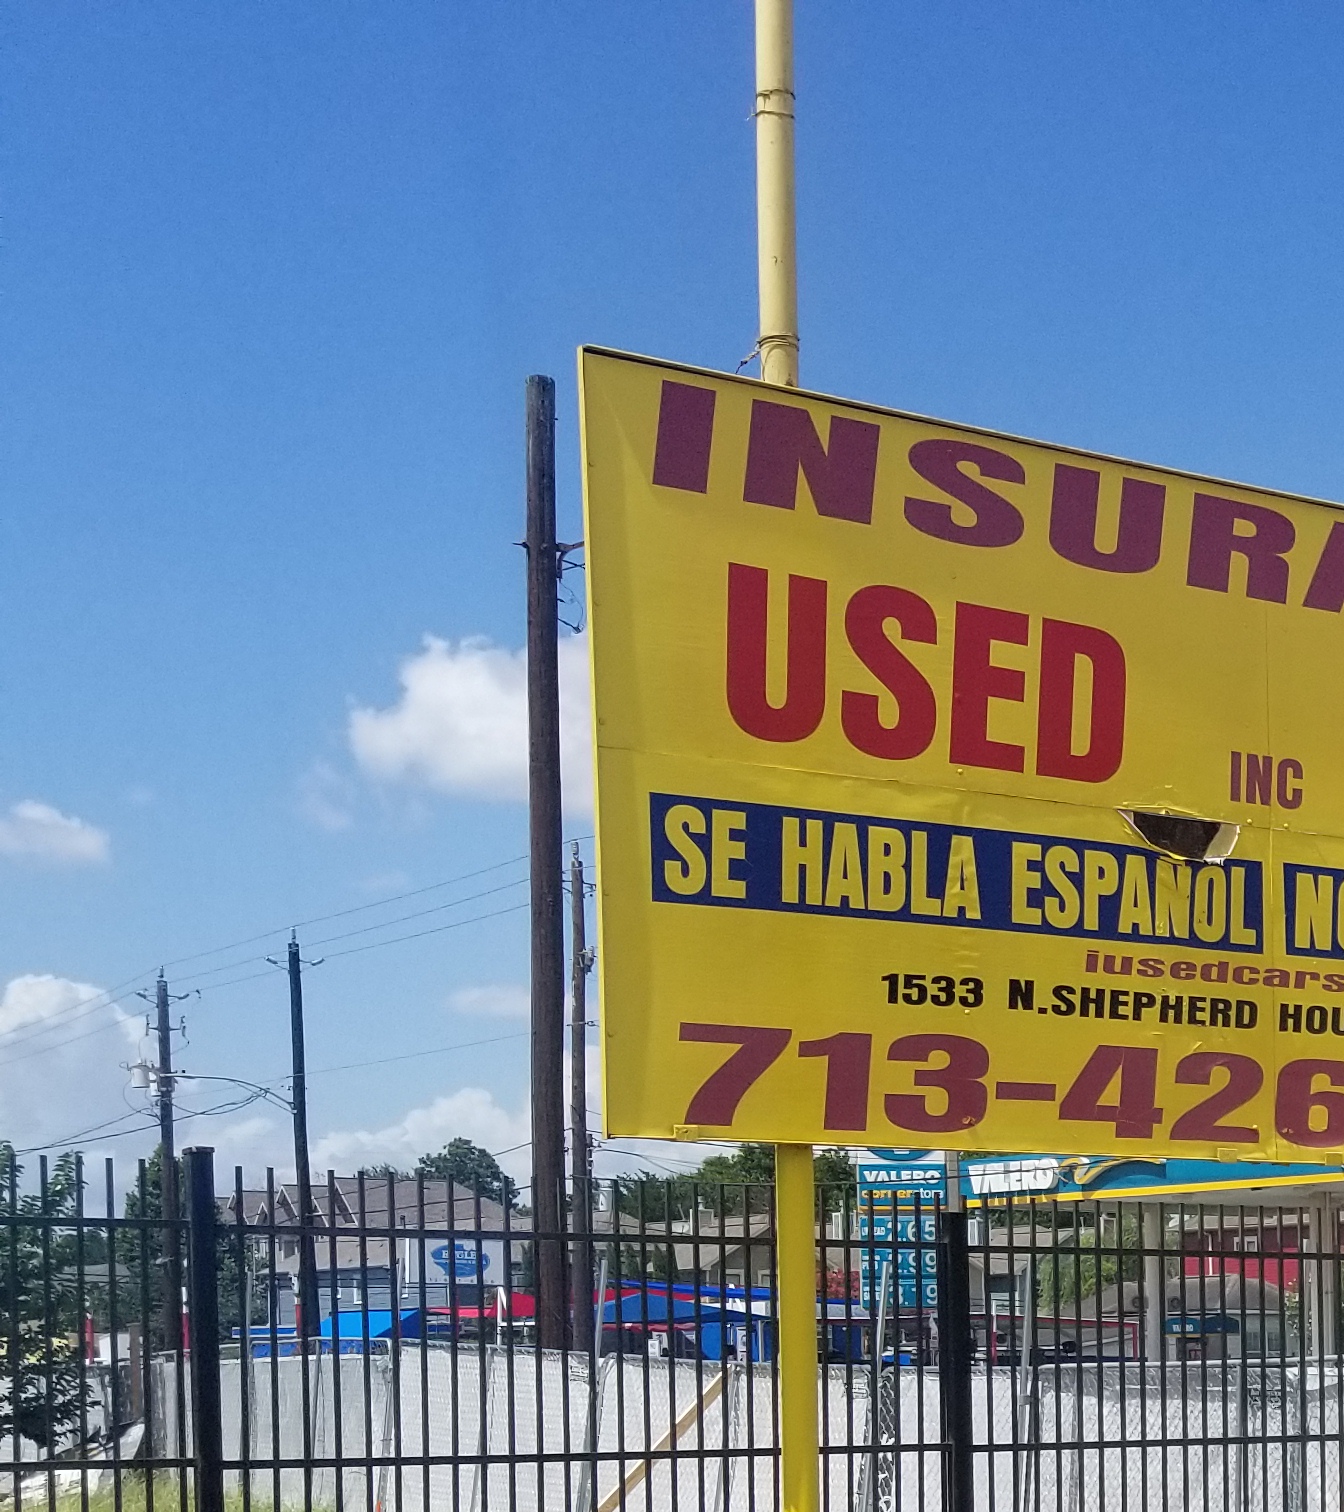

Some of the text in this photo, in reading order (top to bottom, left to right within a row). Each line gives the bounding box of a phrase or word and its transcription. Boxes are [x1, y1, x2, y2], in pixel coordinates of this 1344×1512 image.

[726, 562, 1127, 784] USED
[1229, 751, 1304, 810] INC
[663, 804, 1257, 946] SE HABLA ESPAÑOL
[881, 973, 984, 1008] 1533
[1008, 978, 1258, 1029] N.SHEPHERD
[861, 1188, 944, 1199] cornertore
[863, 1170, 942, 1185] VALERO
[968, 1159, 1059, 1195] VALERO
[442, 1250, 476, 1259] EGLE
